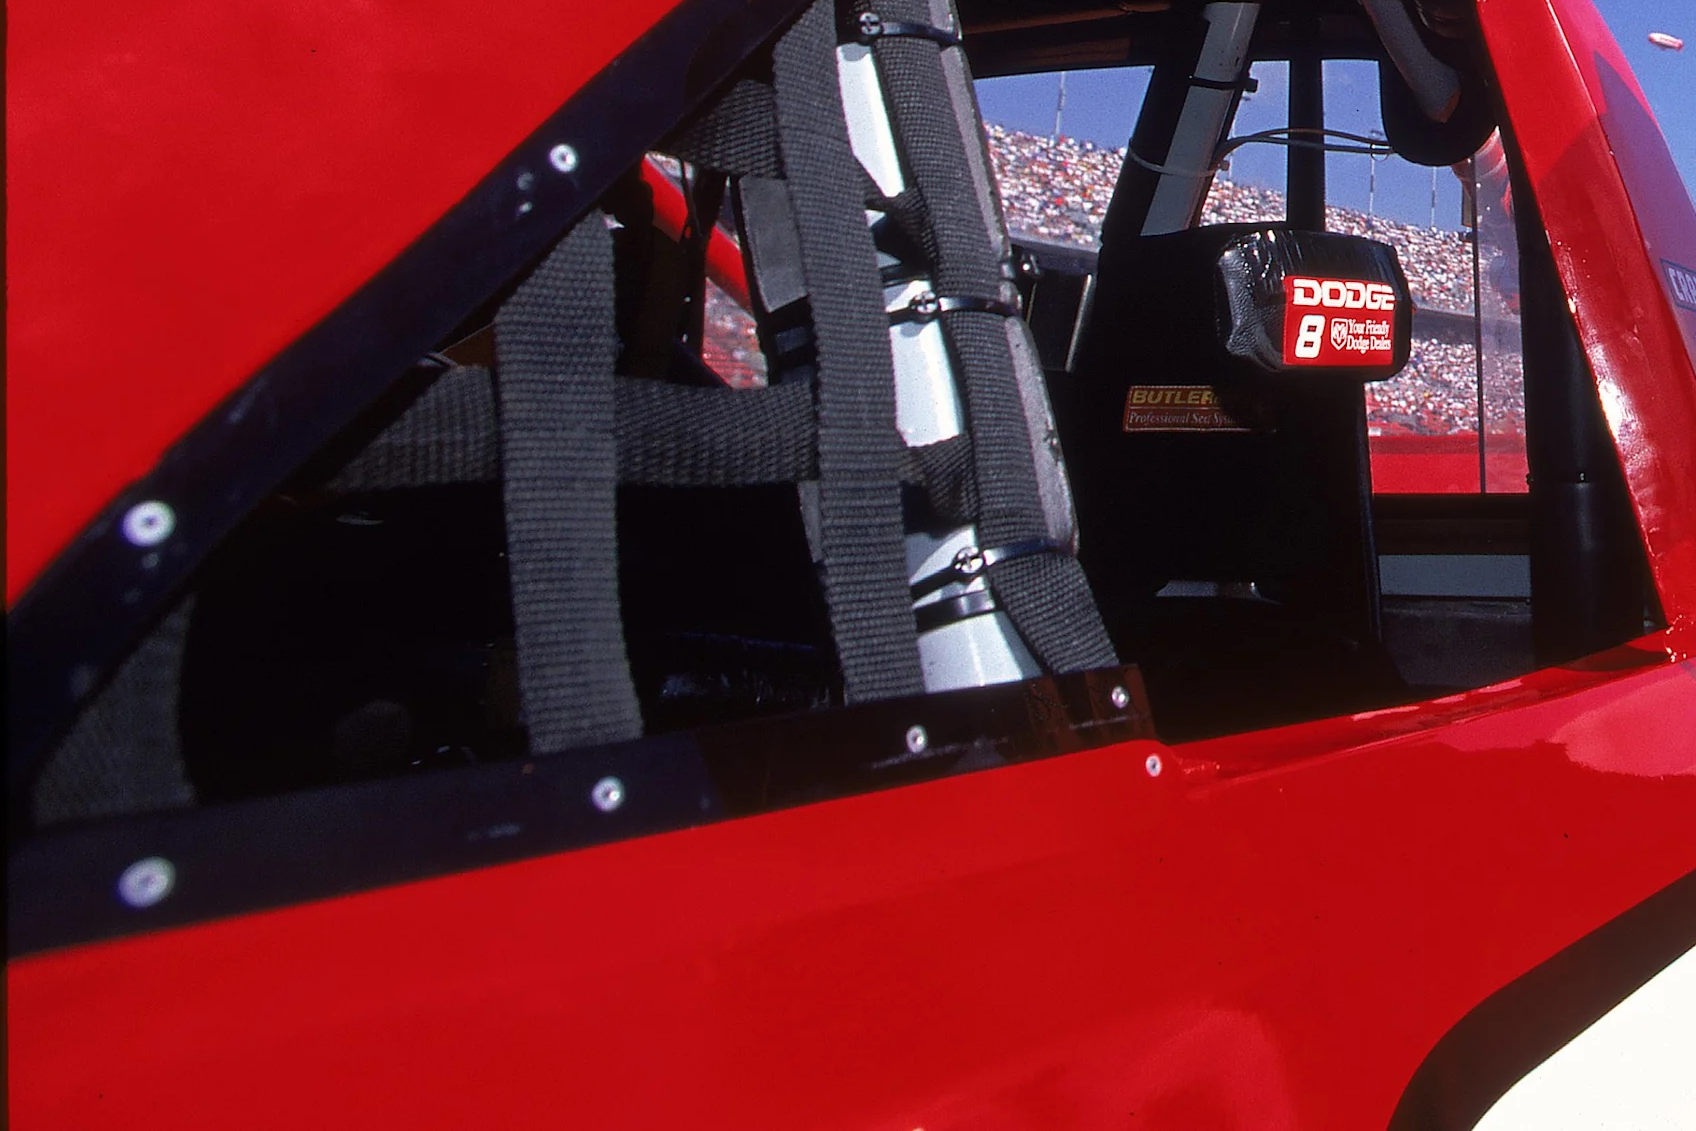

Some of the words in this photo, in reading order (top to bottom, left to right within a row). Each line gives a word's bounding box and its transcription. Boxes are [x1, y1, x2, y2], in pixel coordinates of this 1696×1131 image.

[1292, 278, 1396, 311] DODGE
[1294, 314, 1326, 359] 8
[1347, 318, 1366, 335] Your
[1366, 319, 1390, 338] Friendly
[1346, 335, 1370, 355] Dodge
[1370, 336, 1392, 351] Dealers
[1128, 411, 1189, 425] Professional
